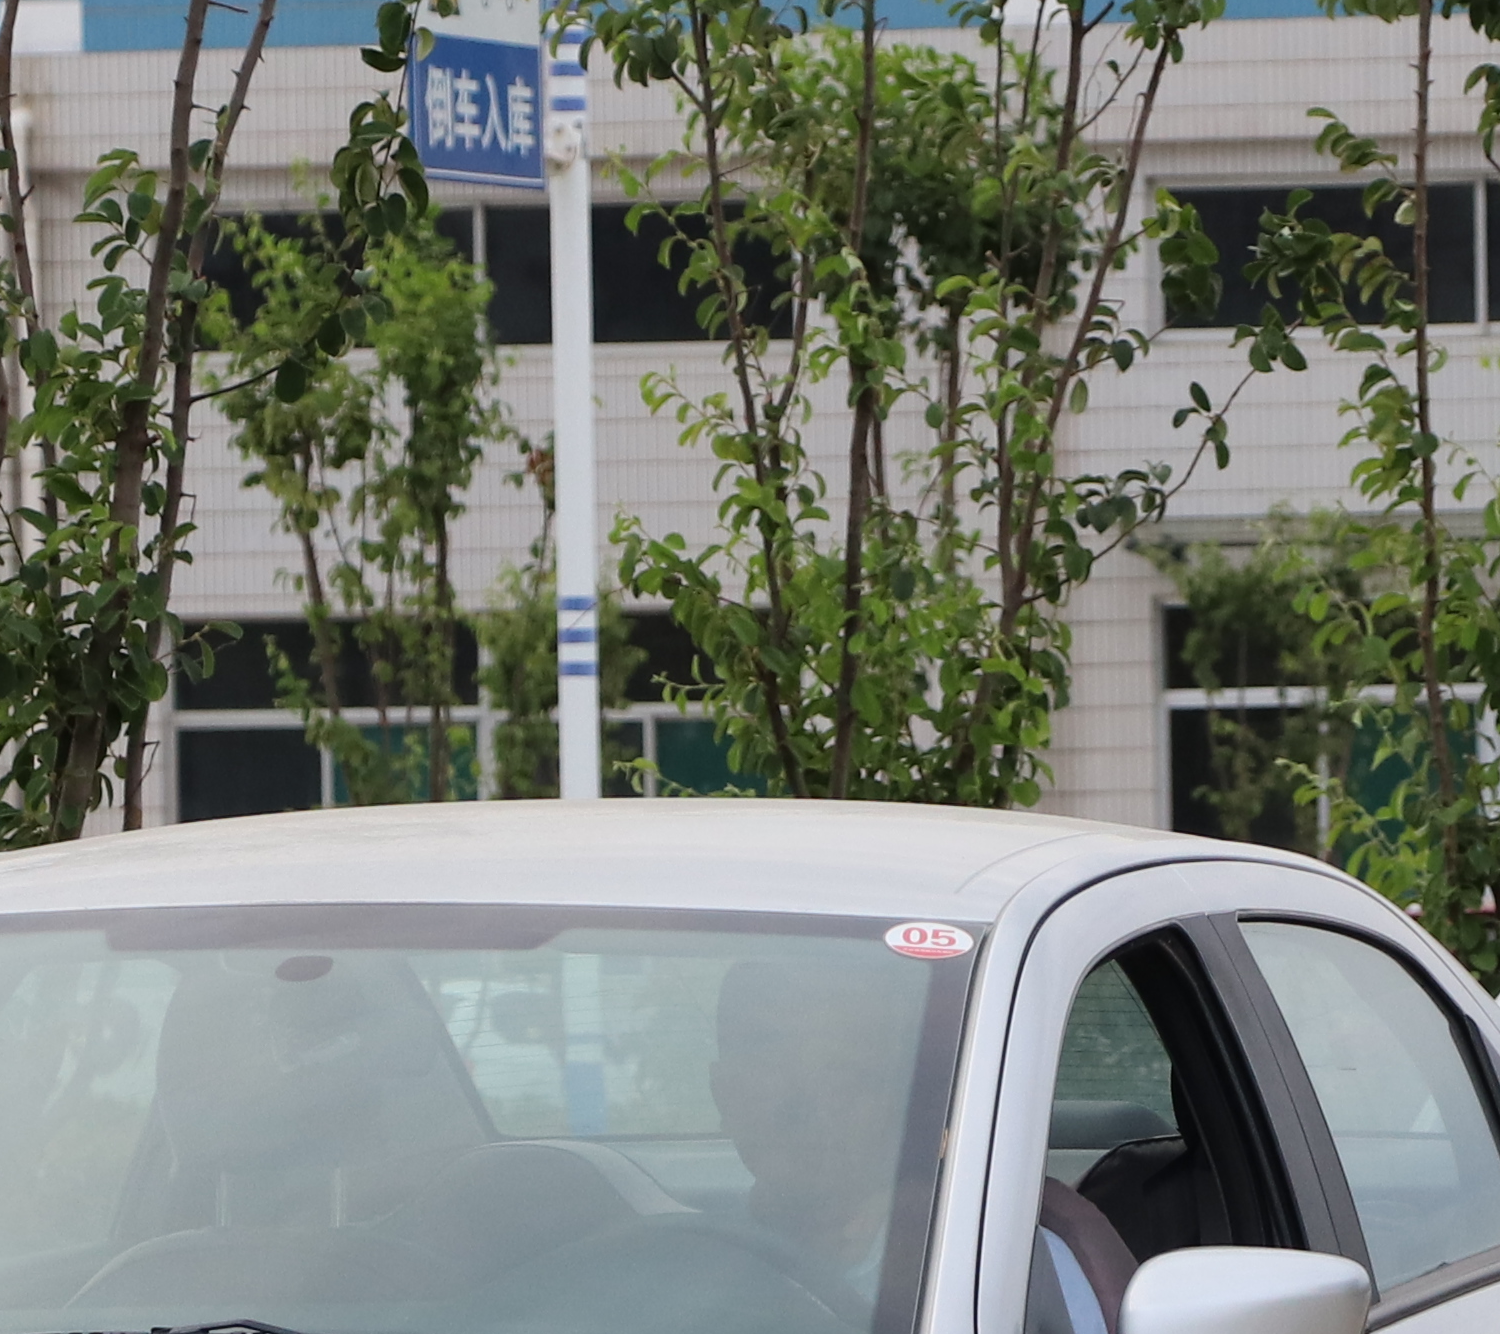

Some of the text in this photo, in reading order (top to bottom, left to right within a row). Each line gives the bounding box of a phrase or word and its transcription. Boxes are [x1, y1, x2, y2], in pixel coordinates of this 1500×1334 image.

[425, 64, 537, 156] 倒车入库
[902, 927, 957, 947] 05
